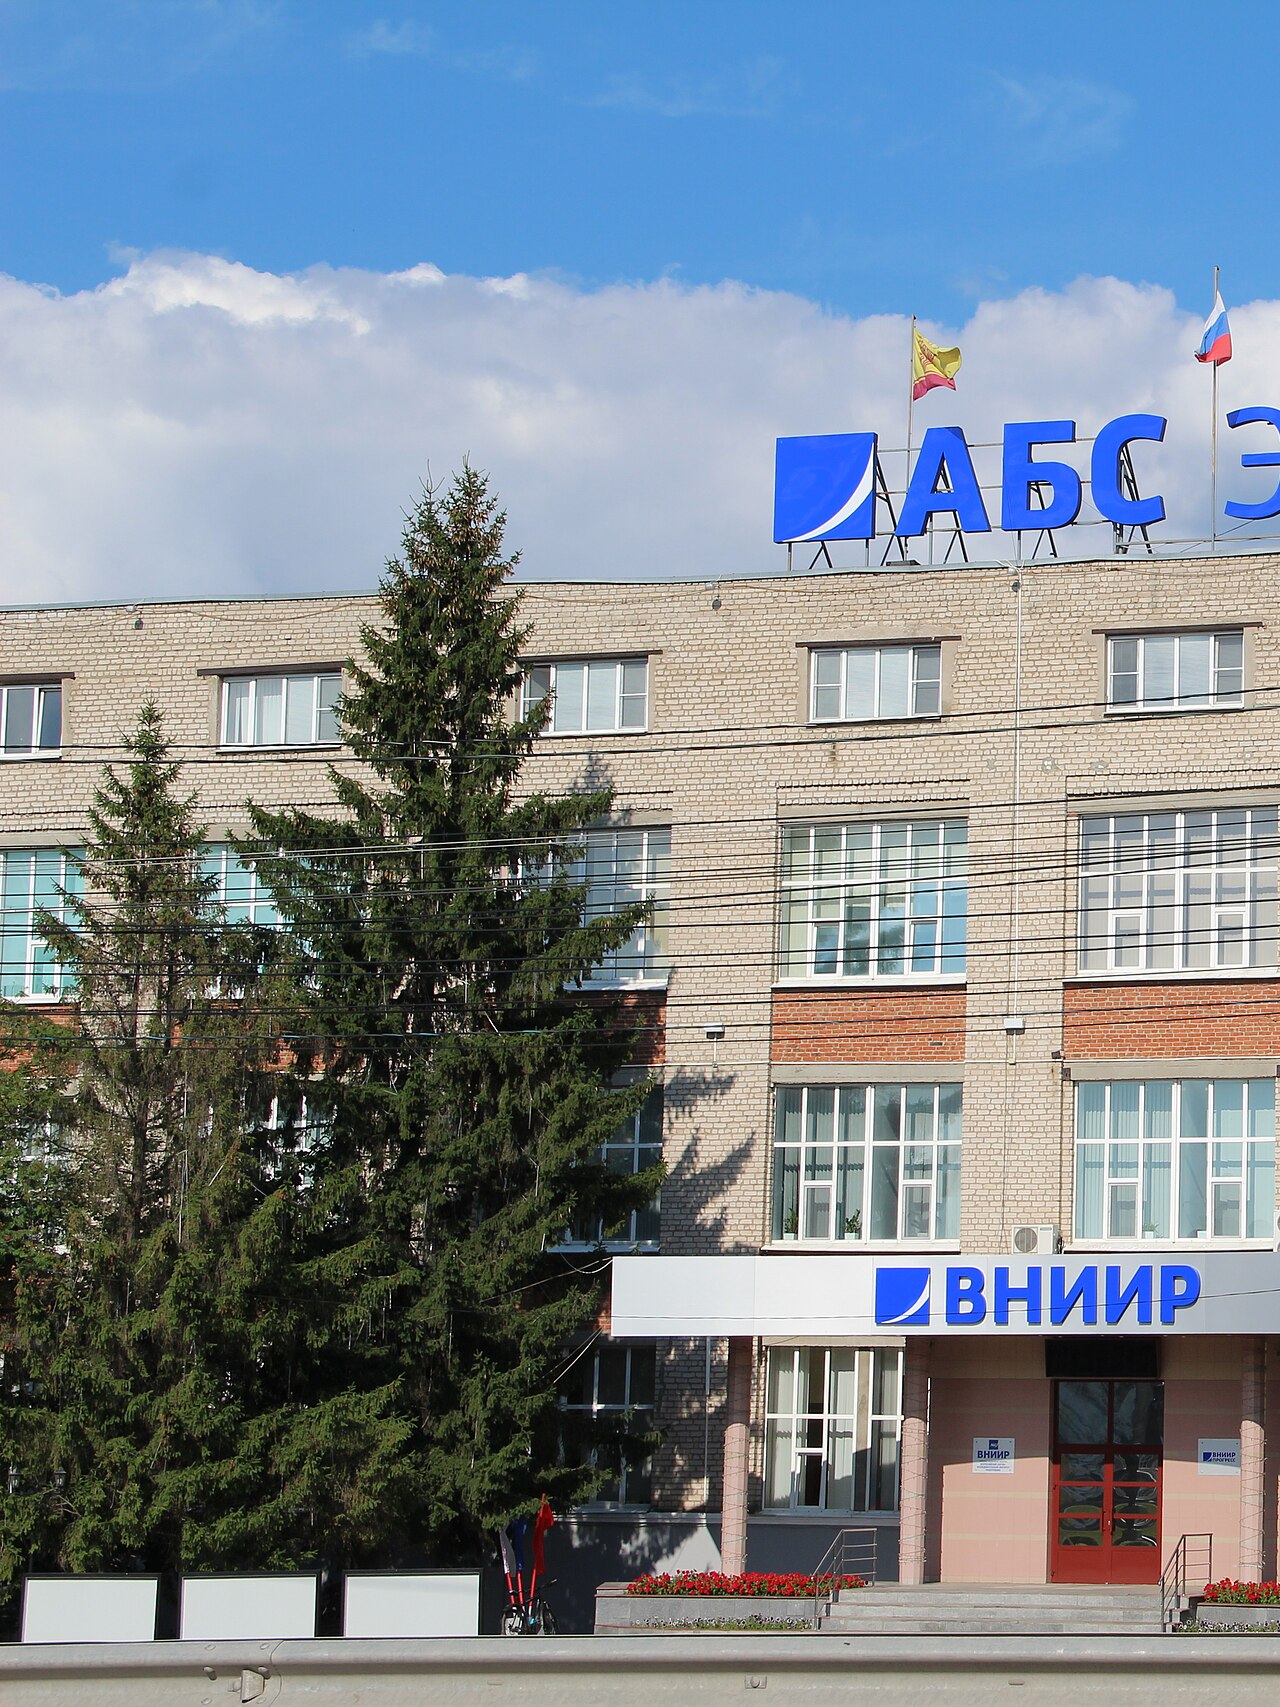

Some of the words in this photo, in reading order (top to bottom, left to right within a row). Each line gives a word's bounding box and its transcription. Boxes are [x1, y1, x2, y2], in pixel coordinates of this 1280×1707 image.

[894, 413, 1167, 537] АБС
[946, 1264, 1201, 1326] ВНИИР
[977, 1450, 1010, 1459] ВНИИР
